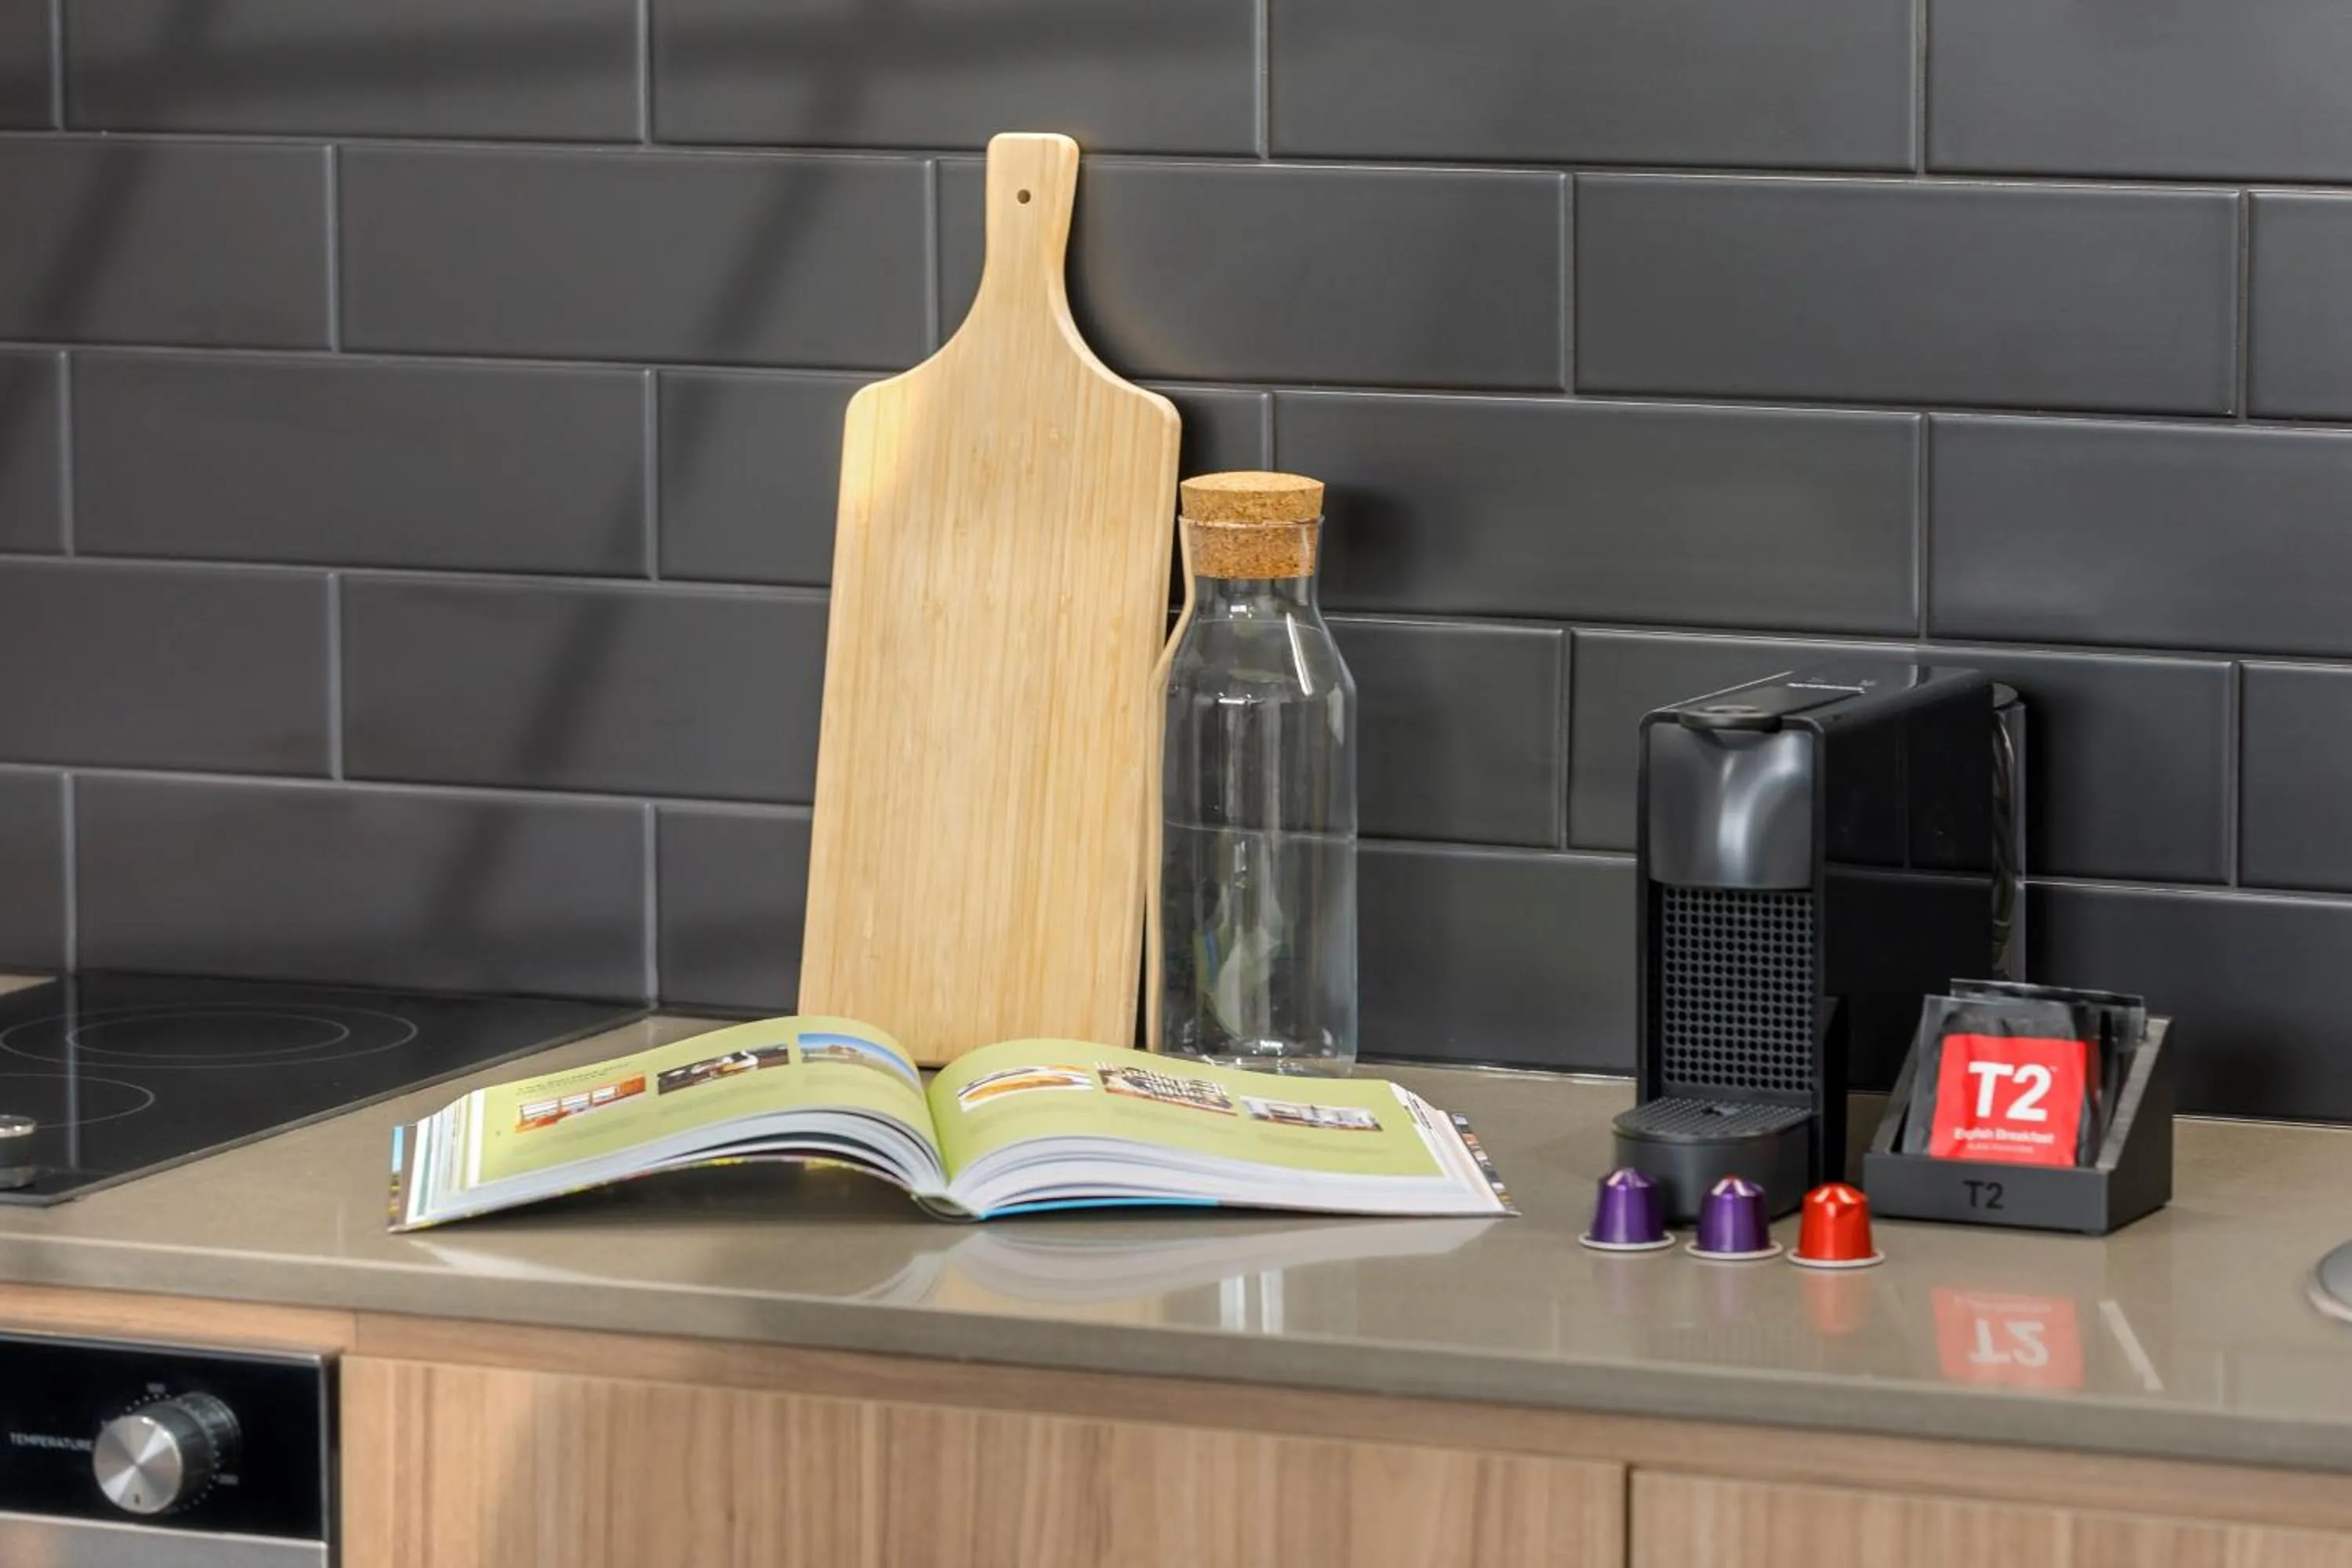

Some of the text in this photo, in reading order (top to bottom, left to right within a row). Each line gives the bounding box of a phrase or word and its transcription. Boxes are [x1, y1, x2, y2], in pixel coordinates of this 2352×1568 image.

[1967, 1060, 2052, 1122] T2
[1962, 1179, 2005, 1210] T2
[9, 1432, 93, 1452] TEMPERATURE
